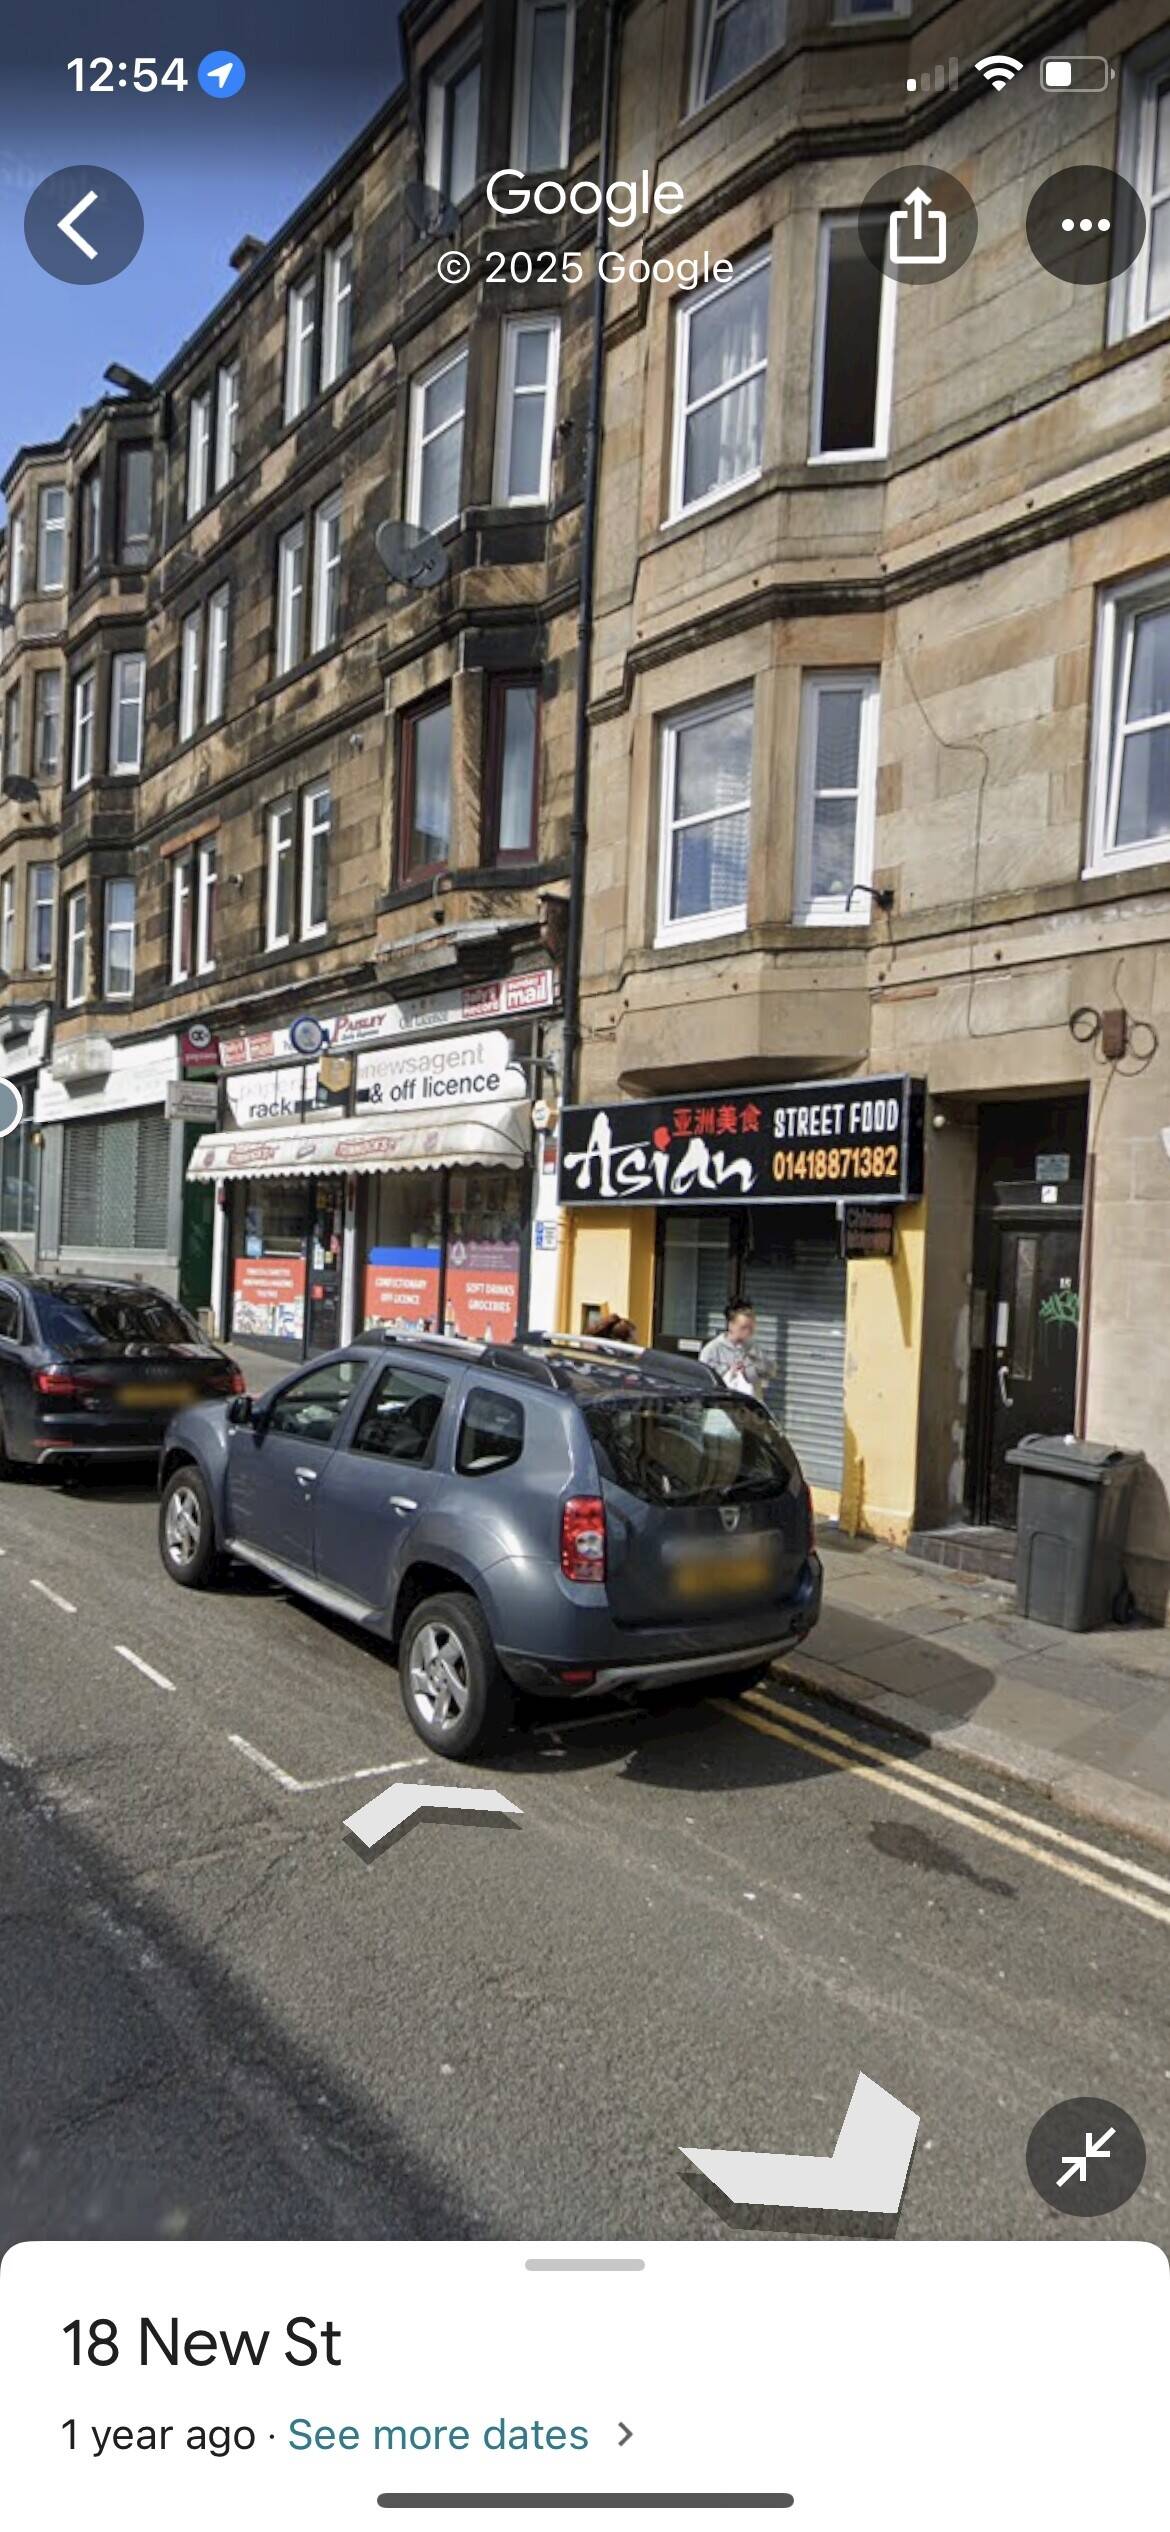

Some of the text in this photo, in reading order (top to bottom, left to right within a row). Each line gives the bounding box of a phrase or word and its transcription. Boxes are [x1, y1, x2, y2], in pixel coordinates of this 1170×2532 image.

[508, 982, 546, 1009] mail
[366, 1042, 485, 1080] newsagent
[370, 1072, 501, 1103] & off licence
[249, 1096, 292, 1119] rack
[672, 1103, 762, 1138] 亚洲美食
[774, 1098, 899, 1139] STREET FOOD
[564, 1111, 758, 1198] Asian
[772, 1144, 898, 1182] 01418871382
